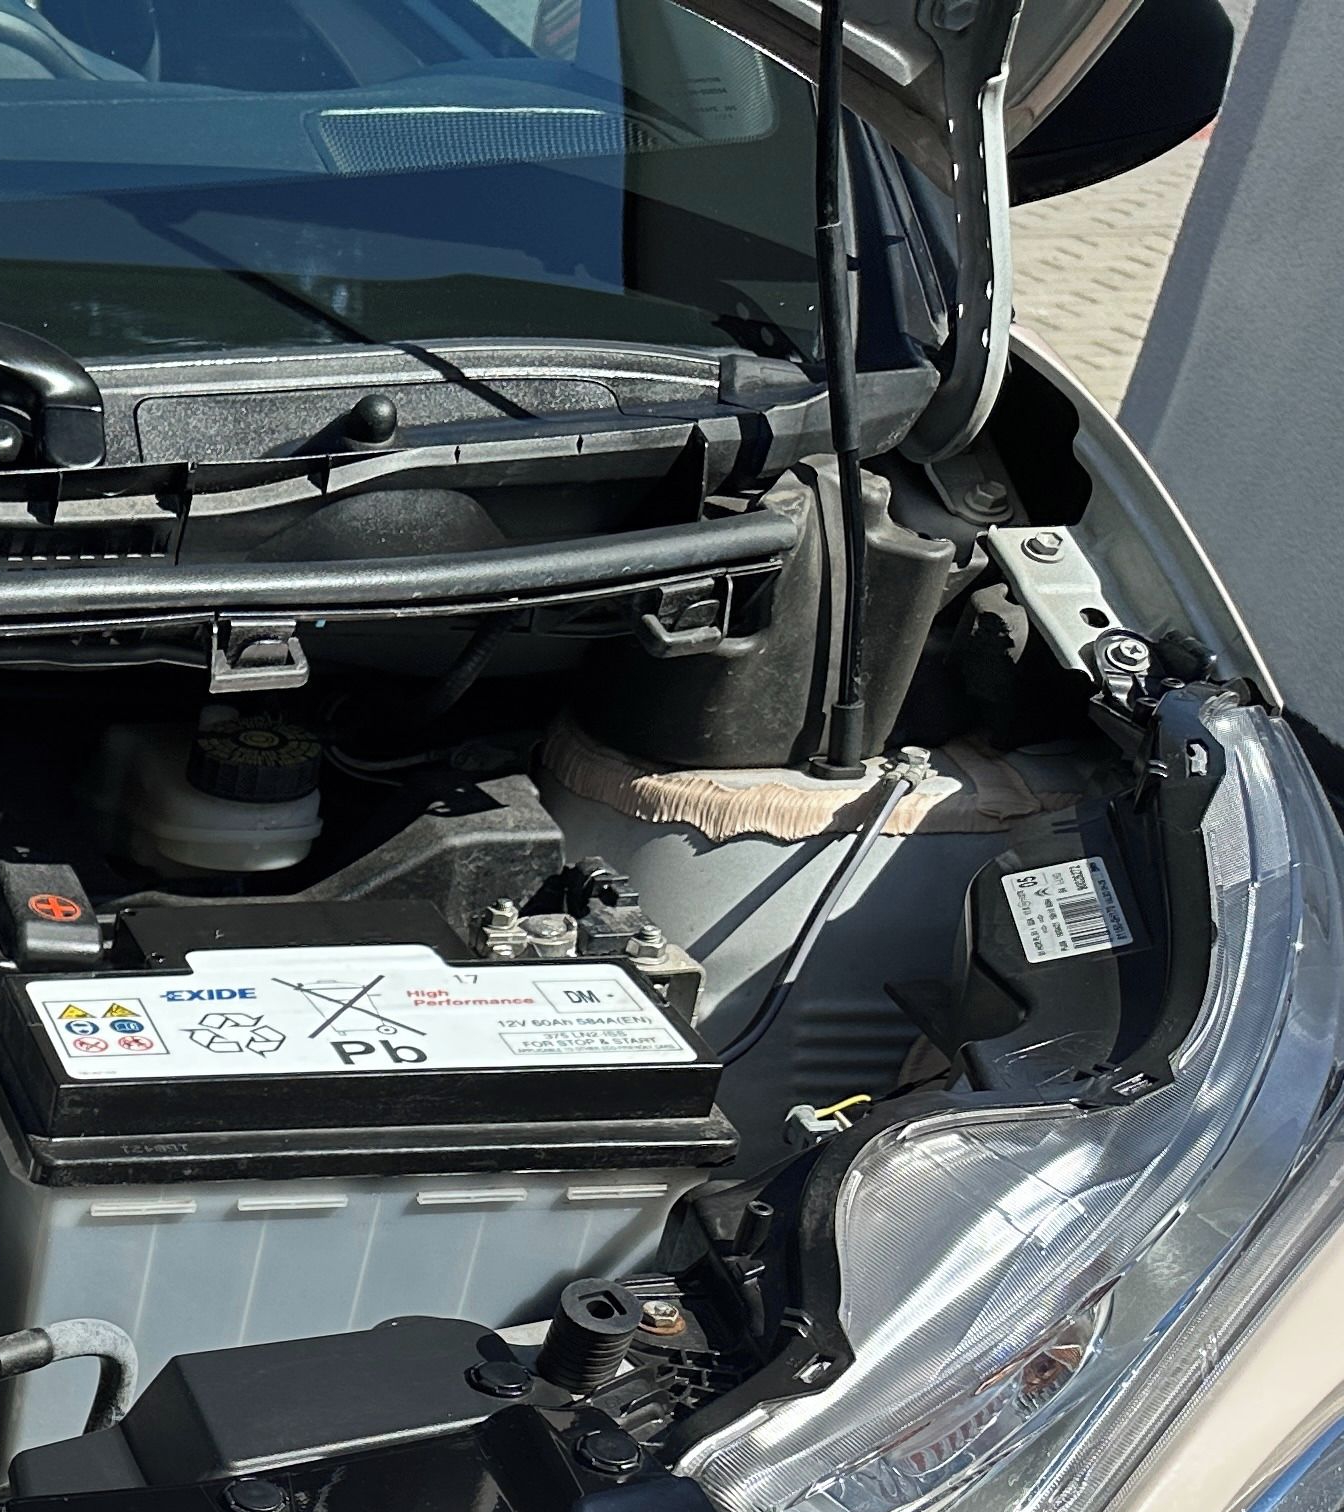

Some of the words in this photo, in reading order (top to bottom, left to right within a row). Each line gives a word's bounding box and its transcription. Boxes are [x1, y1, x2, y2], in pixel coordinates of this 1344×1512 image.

[1016, 876, 1038, 888] 05
[161, 987, 257, 1002] EXIDE
[406, 990, 449, 998] High
[563, 990, 601, 1004] DM
[414, 998, 535, 1006] Performance
[497, 1020, 526, 1028] 12V
[532, 1018, 573, 1027] 60Ah
[556, 1039, 596, 1047] STOP
[612, 1037, 657, 1045] START
[330, 1040, 428, 1066] Pb
